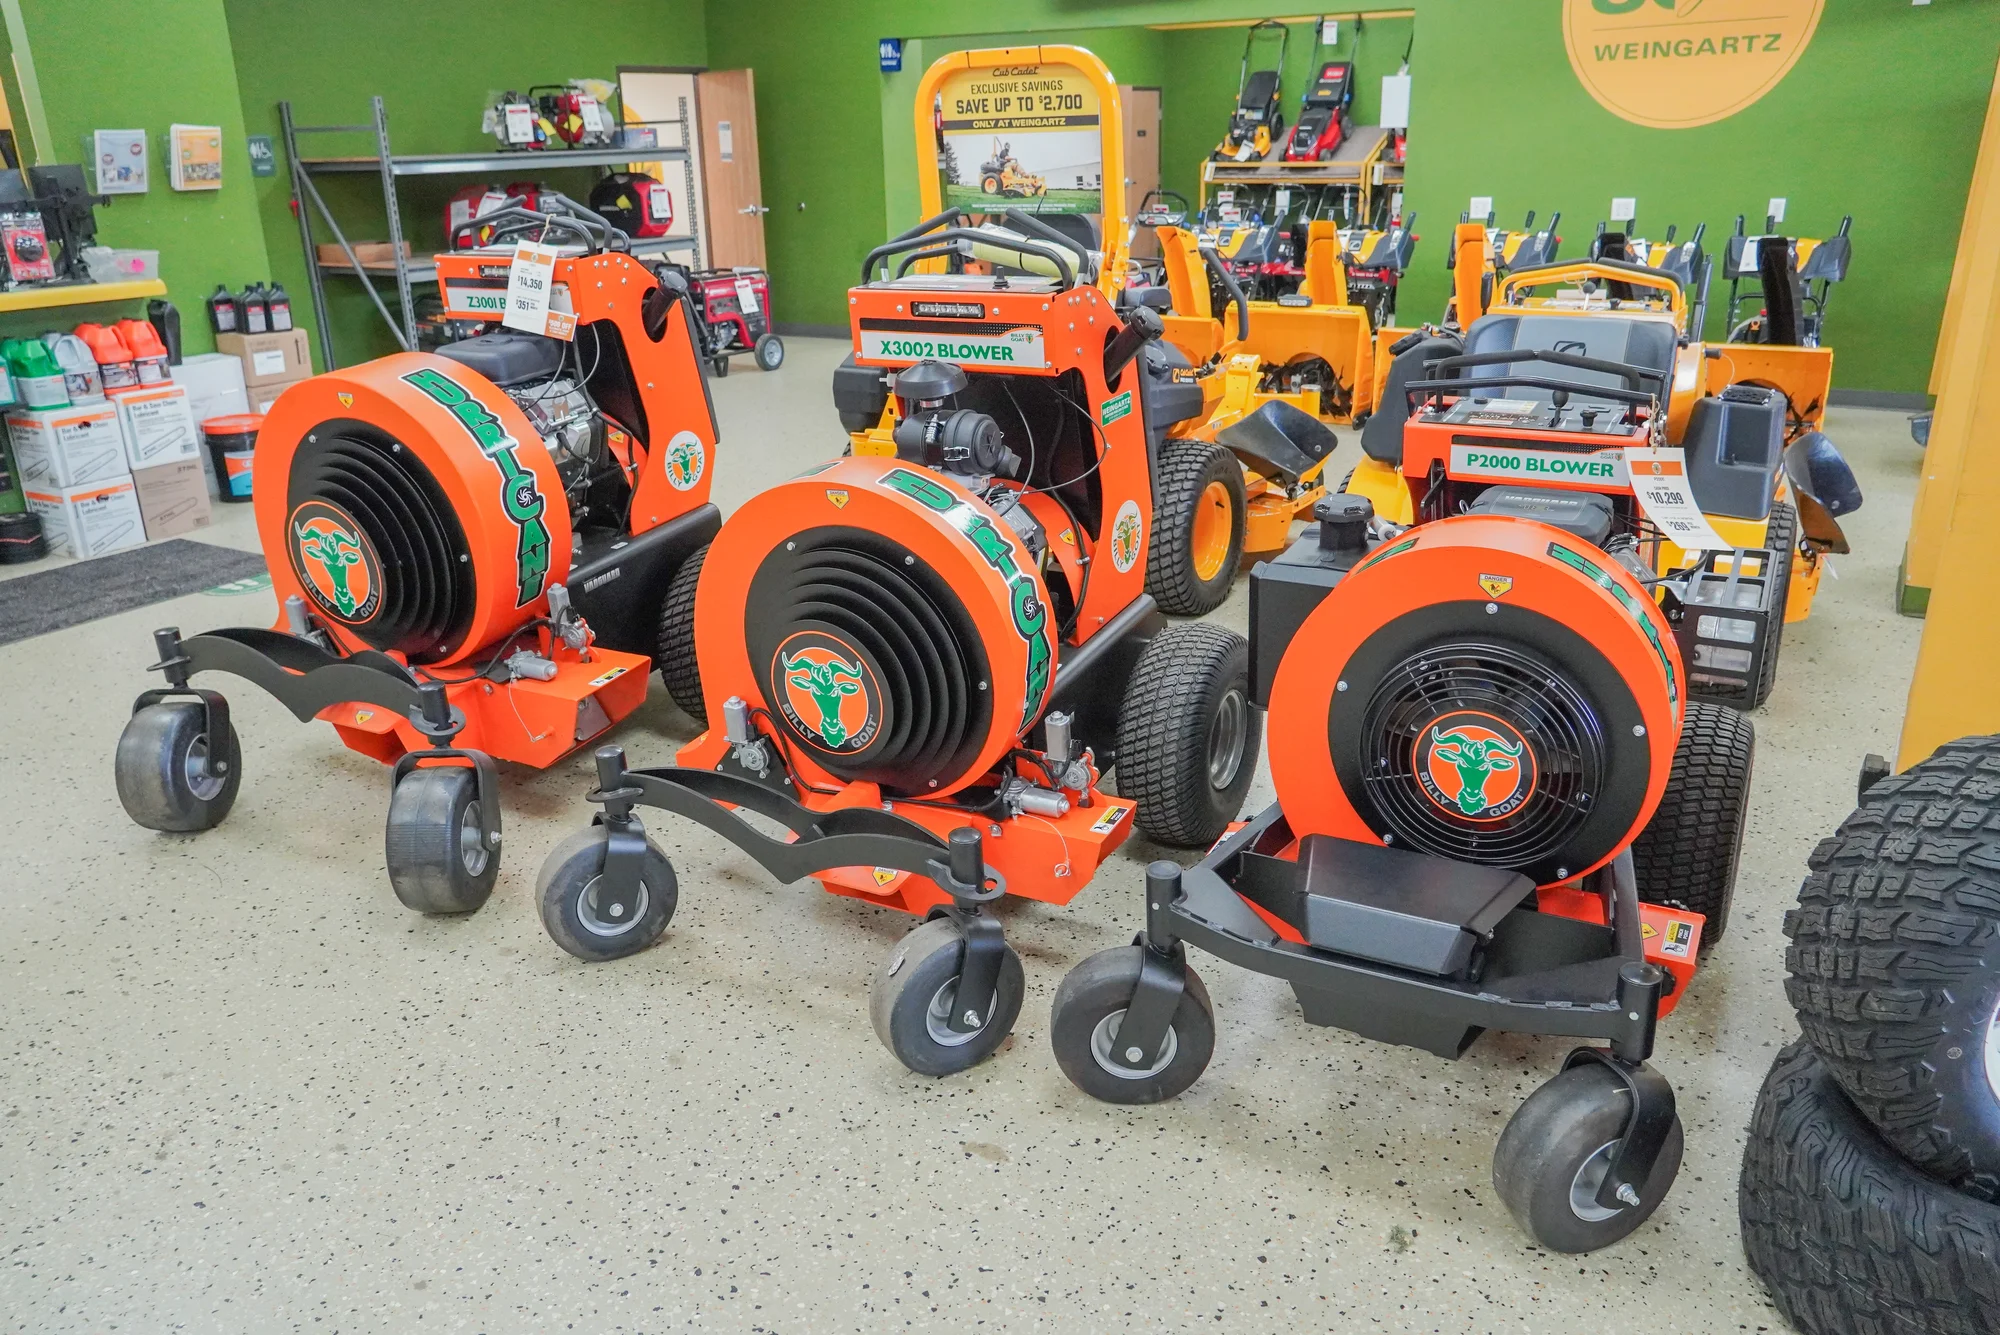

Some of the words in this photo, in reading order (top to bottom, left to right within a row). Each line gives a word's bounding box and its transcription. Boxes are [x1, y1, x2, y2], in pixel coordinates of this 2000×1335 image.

[1594, 33, 1782, 62] WEINGARTZ
[992, 68, 1009, 77] Cub
[1011, 66, 1039, 76] Cadet
[971, 83, 1020, 95] EXCLUSIVE
[1022, 80, 1063, 92] SAVINGS
[956, 99, 989, 114] SAVE
[994, 98, 1011, 112] UP
[1017, 96, 1034, 111] TO
[1039, 94, 1083, 112] $2,700
[973, 120, 995, 129] ONLY
[997, 119, 1011, 127] AT
[1011, 117, 1066, 127] WEINGARTZ
[880, 340, 934, 358] X3002
[938, 343, 1014, 361] BLOWER
[667, 462, 682, 487] BILLY
[693, 450, 702, 482] GOAT
[1467, 453, 1521, 470] P2000
[1525, 457, 1614, 478] BLOWER
[1646, 491, 1684, 505] $10,299
[584, 567, 620, 593] VANGUARD
[1484, 575, 1508, 583] DANGER
[302, 573, 331, 608] BILLY
[360, 584, 378, 617] GOAT
[782, 703, 815, 740] BILLY
[851, 715, 875, 749] GOAT
[1419, 771, 1450, 806] BILLY
[1489, 792, 1524, 817] GOAT
